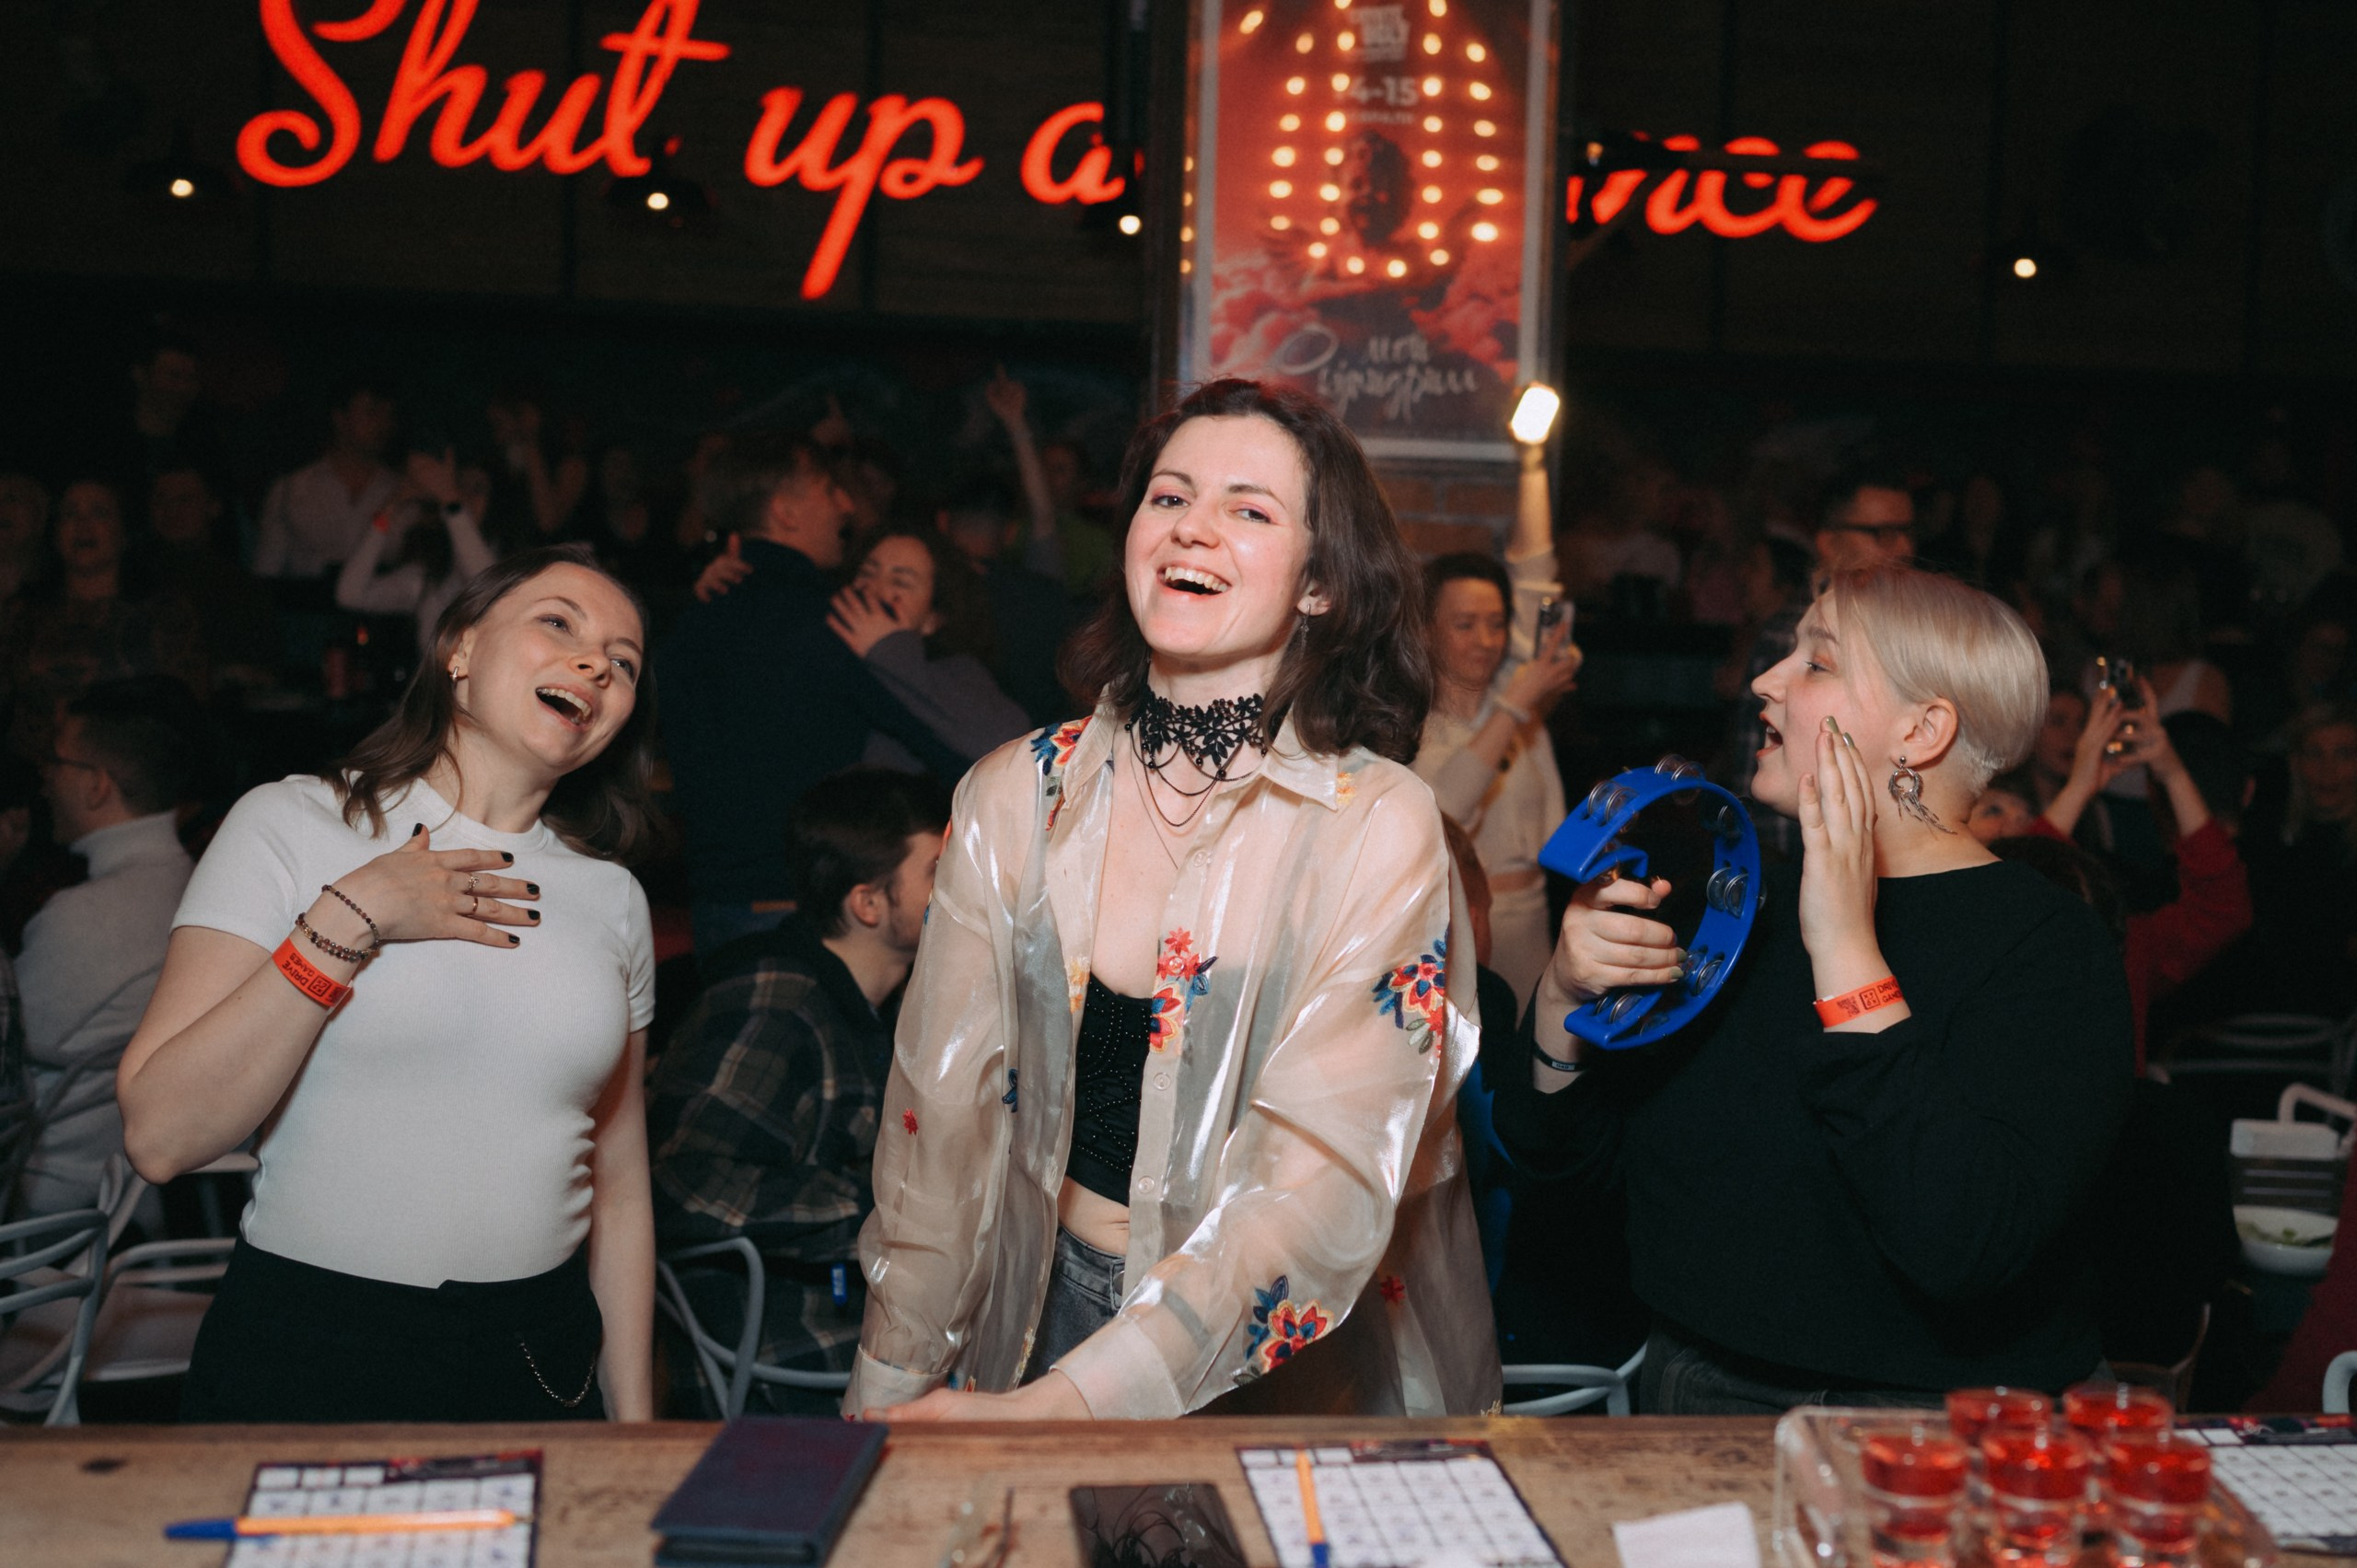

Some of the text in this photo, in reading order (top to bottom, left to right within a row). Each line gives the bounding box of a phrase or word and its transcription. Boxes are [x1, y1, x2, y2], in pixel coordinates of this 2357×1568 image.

[237, 0, 730, 187] Shut
[744, 86, 984, 299] up
[282, 959, 309, 986] DRIVE
[289, 952, 315, 978] GAMES
